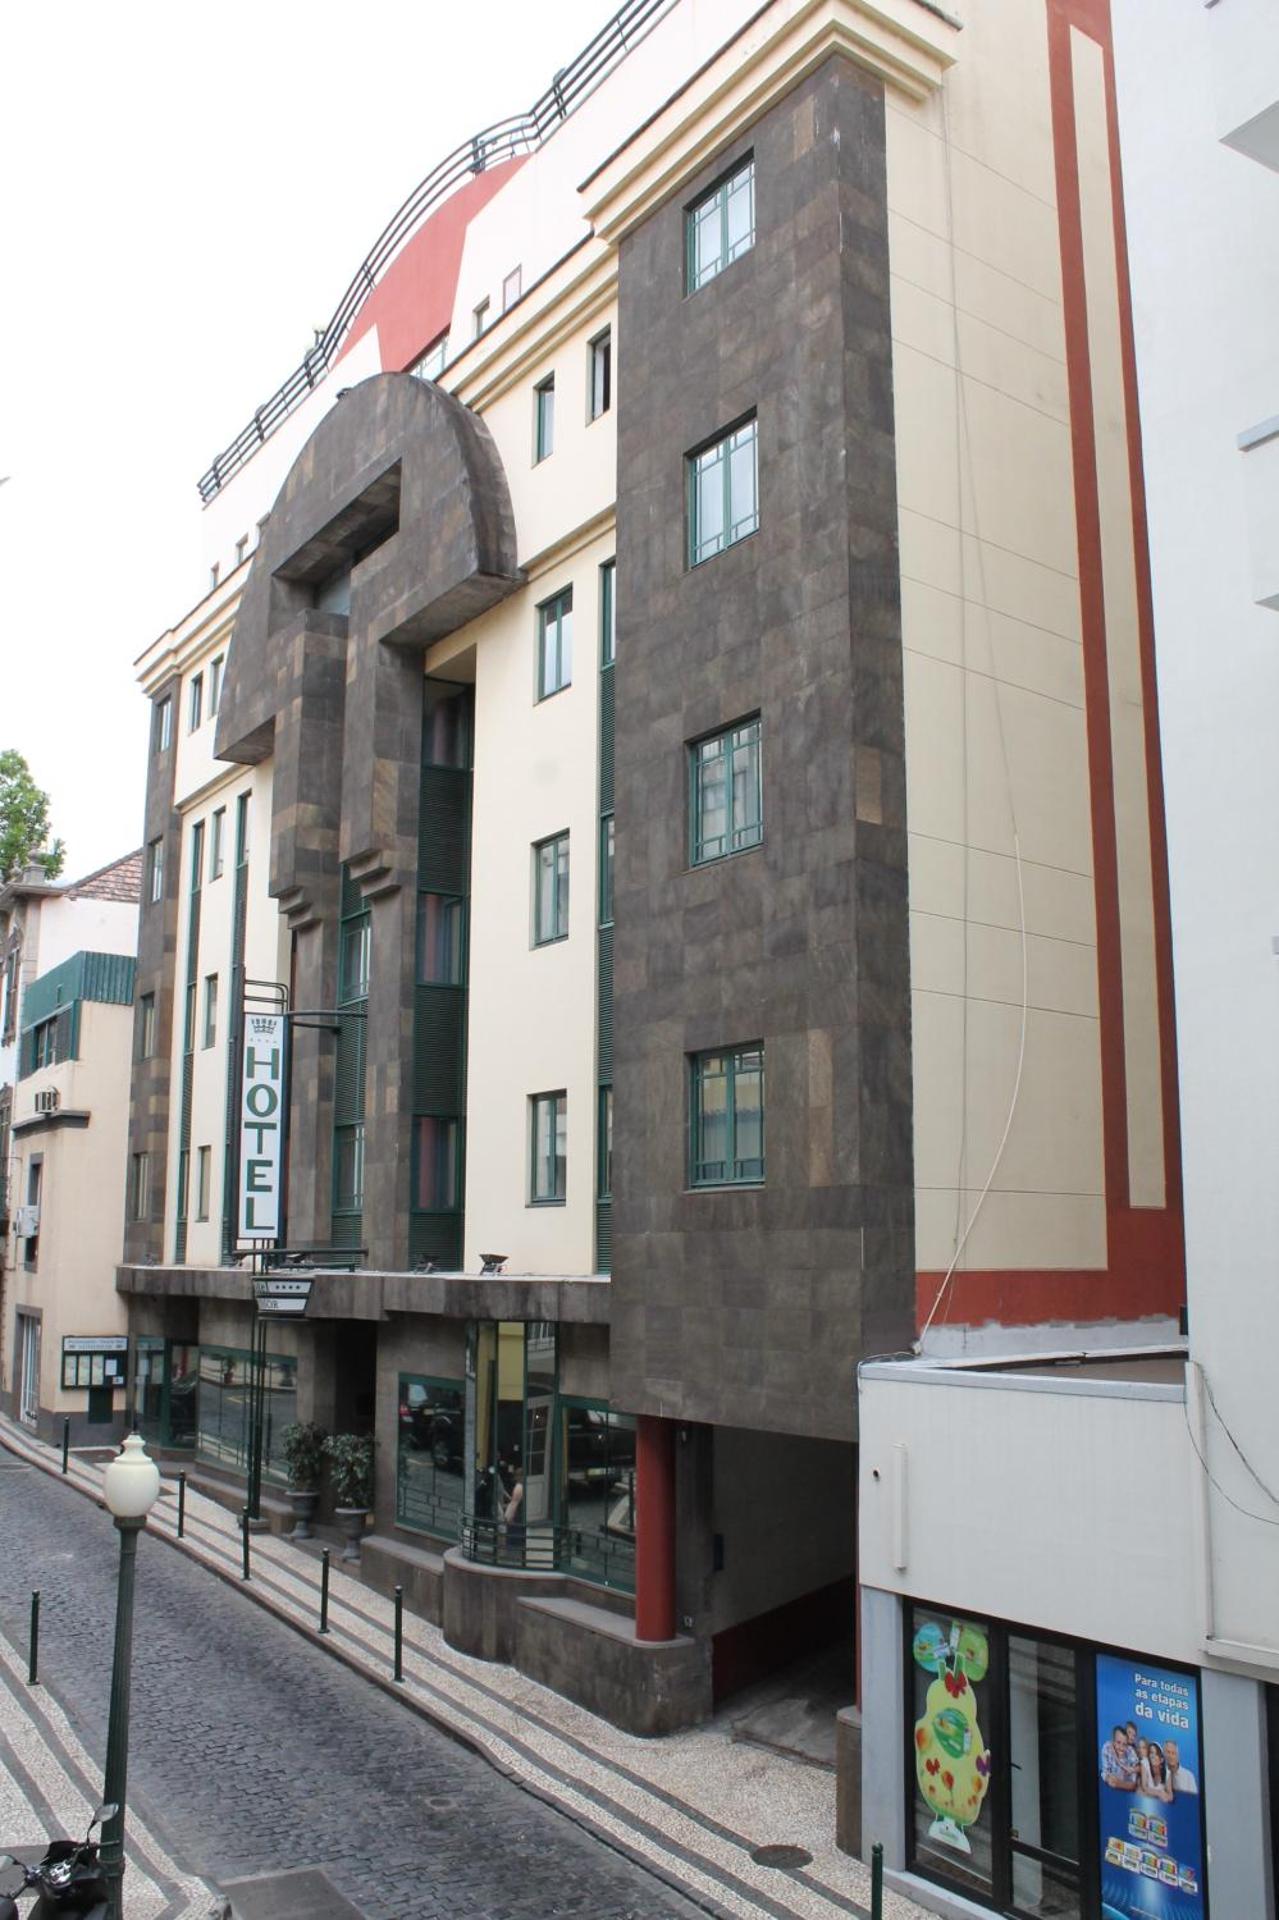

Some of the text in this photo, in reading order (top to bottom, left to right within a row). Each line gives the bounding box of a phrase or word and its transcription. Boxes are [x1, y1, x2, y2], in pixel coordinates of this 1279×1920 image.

[244, 1046, 280, 1230] HOTEL
[1135, 1673, 1189, 1696] Para todas
[1135, 1689, 1189, 1710] as etapas
[1135, 1702, 1189, 1729] da vida
